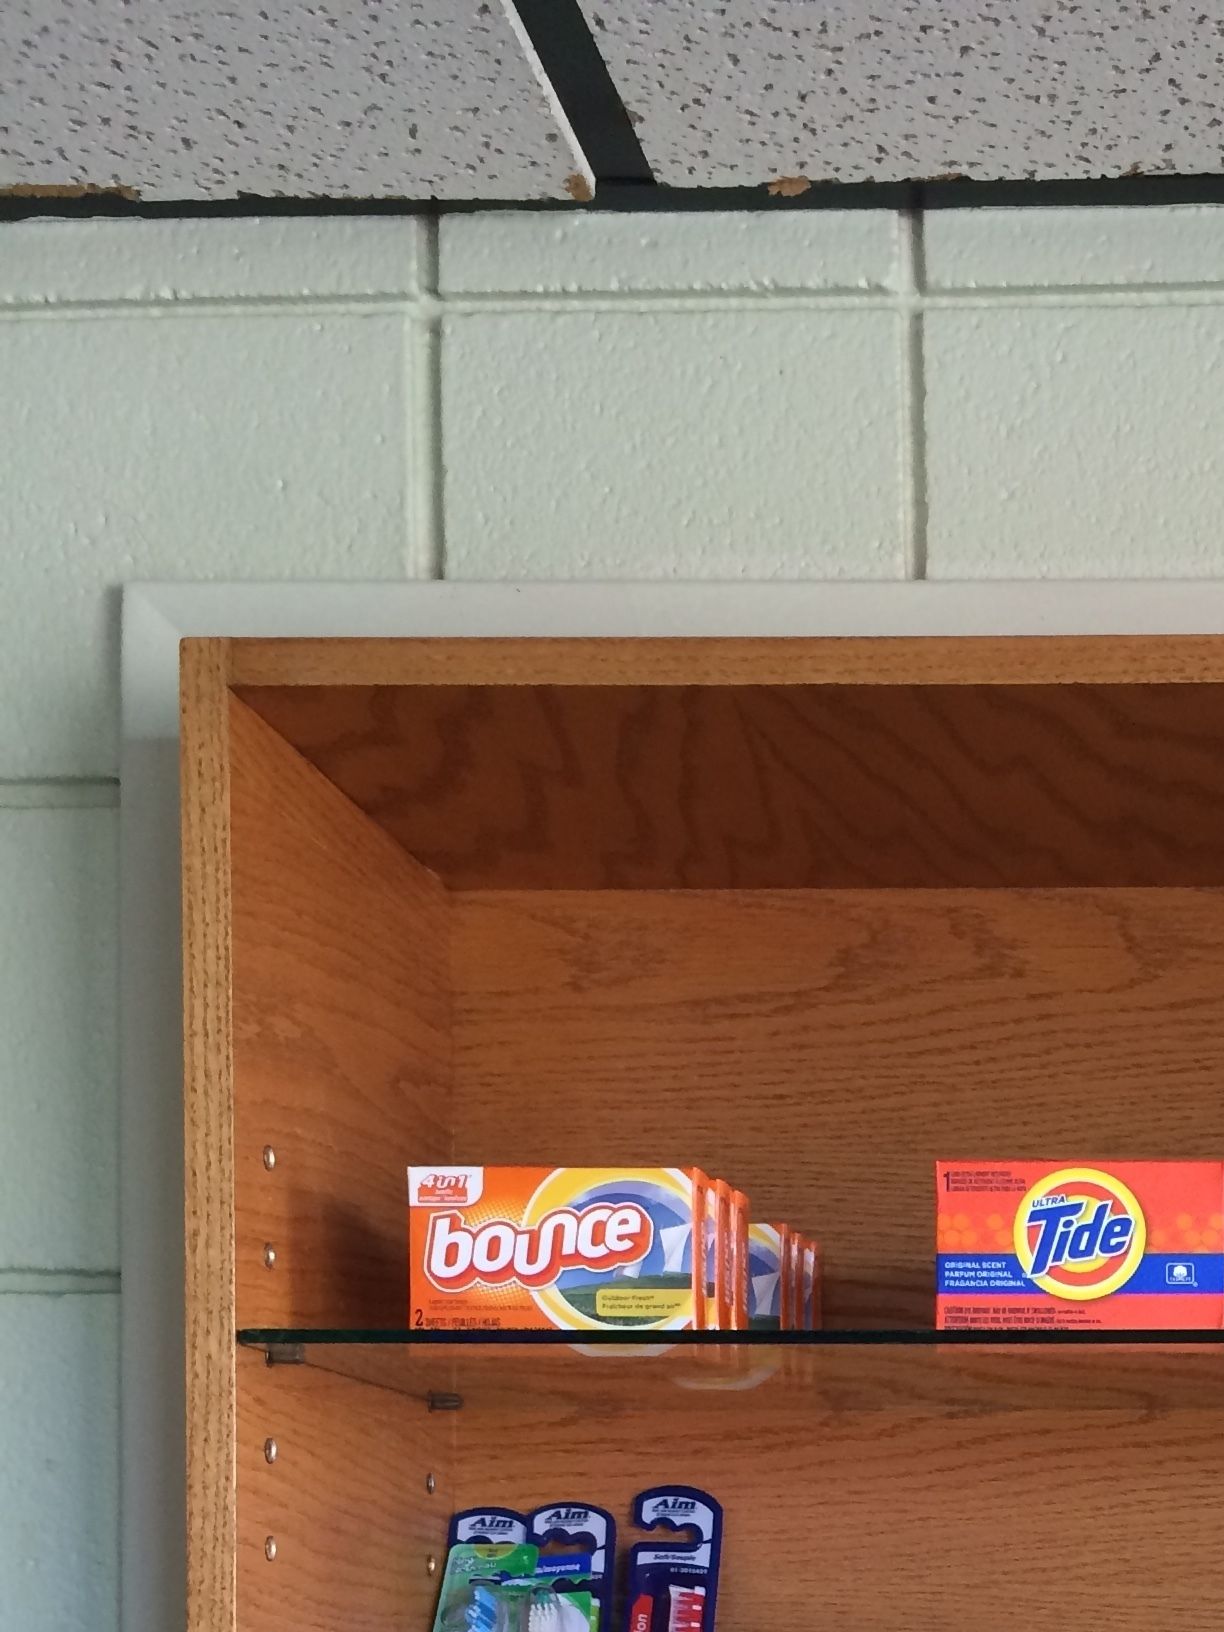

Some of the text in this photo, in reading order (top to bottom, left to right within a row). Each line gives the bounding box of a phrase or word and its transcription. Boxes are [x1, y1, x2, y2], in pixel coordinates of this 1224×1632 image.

[1032, 1196, 1065, 1208] ULTRA
[428, 1205, 645, 1284] bounce
[1027, 1201, 1135, 1277] Tide
[944, 1261, 1006, 1269] ORIGINAL SCENT
[944, 1270, 1013, 1279] PARFUM ORIGINAL
[989, 1279, 1025, 1287] ORIGINAL
[414, 1309, 423, 1326] 2
[654, 1498, 697, 1509] Aim
[546, 1509, 589, 1520] Aim
[470, 1517, 514, 1527] Aim
